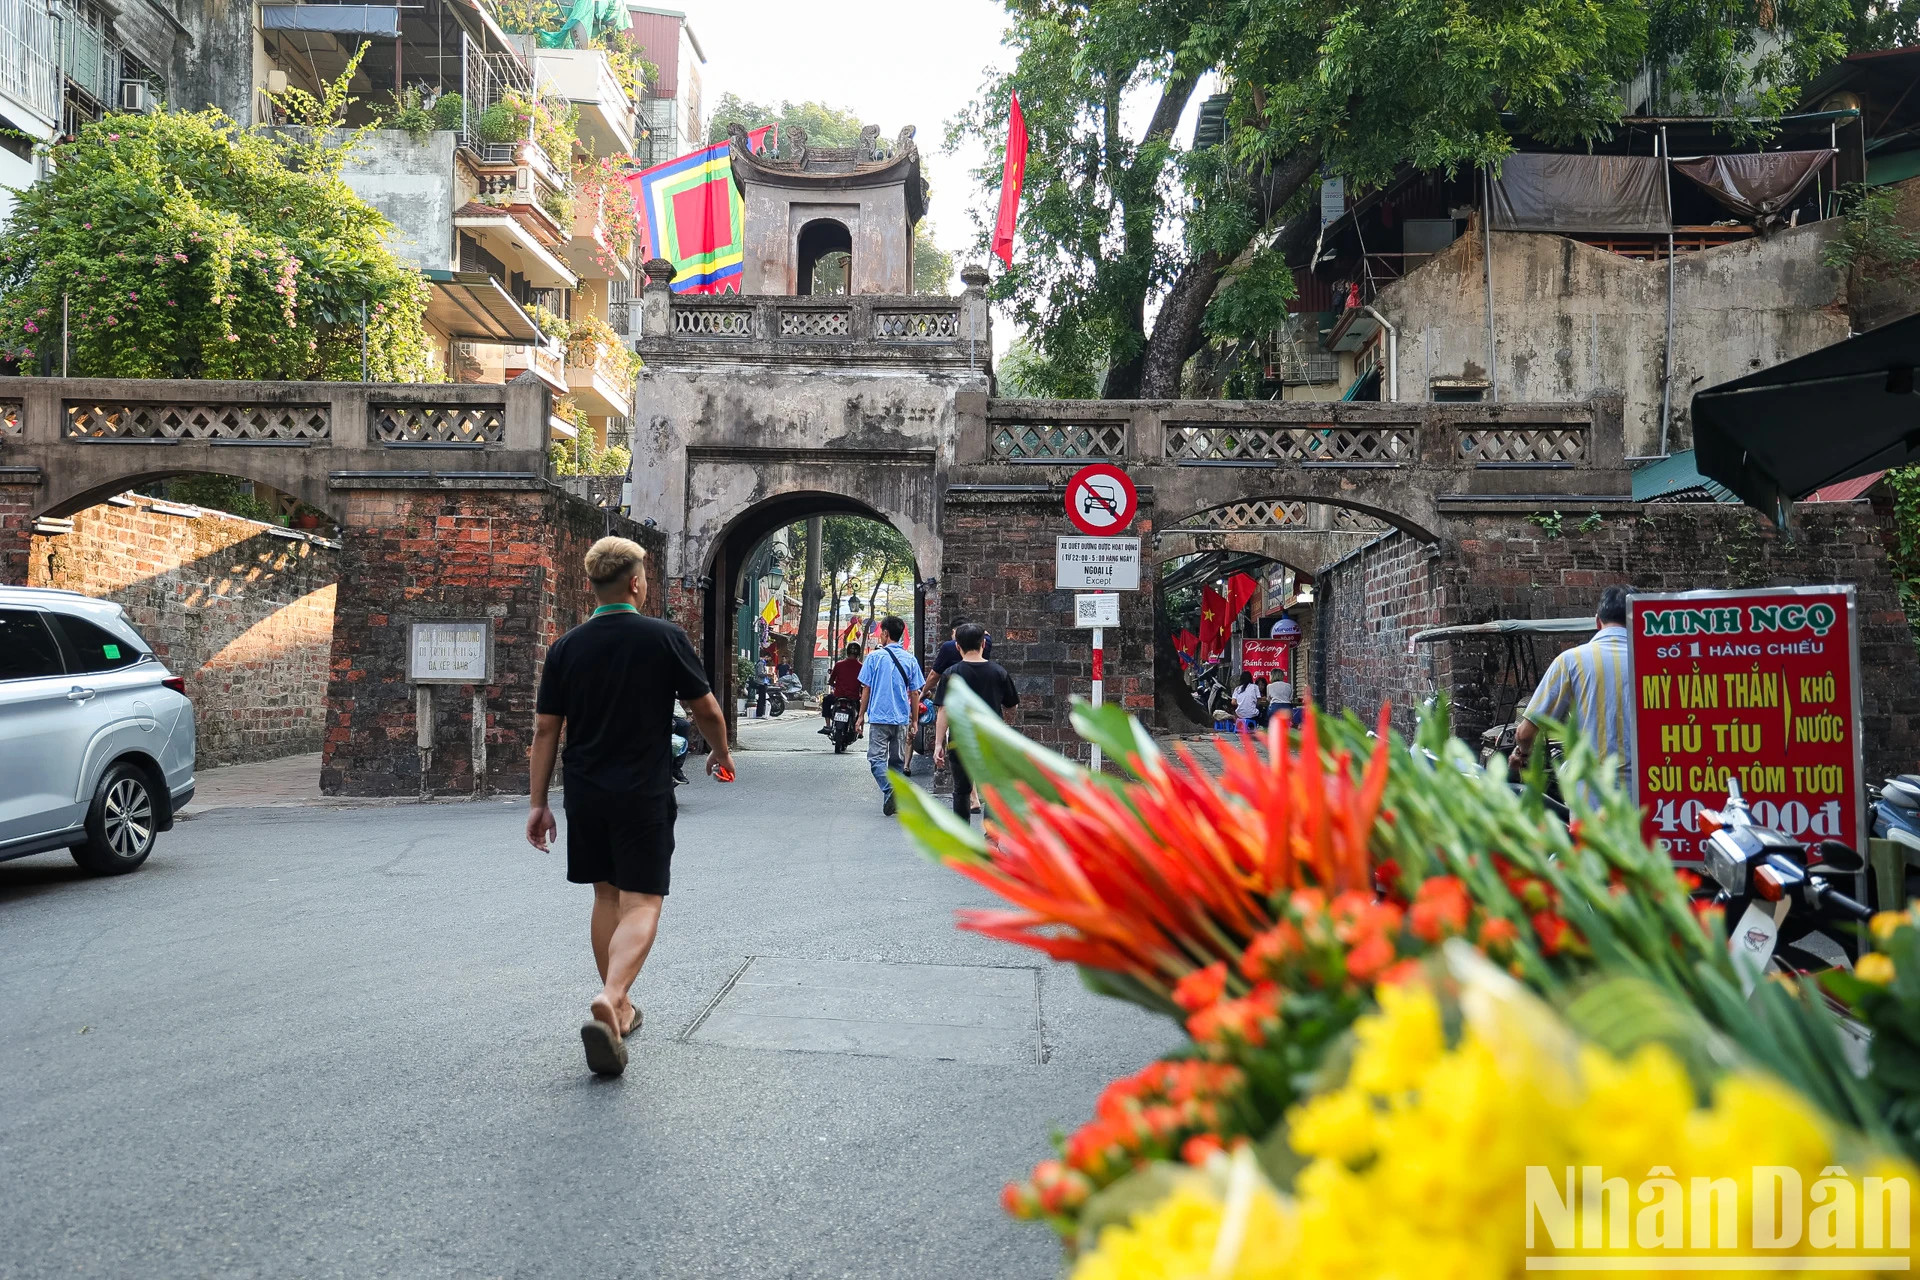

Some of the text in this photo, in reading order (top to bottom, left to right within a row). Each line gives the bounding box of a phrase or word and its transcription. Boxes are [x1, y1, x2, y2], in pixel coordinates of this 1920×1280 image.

[1084, 564, 1113, 576] NGOẠI LỆ
[1086, 576, 1111, 586] Except
[1642, 603, 1836, 636] MINH NGỌ
[1657, 637, 1824, 658] SỐ 1 HÀNG CHIẾU
[1643, 661, 1778, 709] MỲ VẰN THẮN
[1800, 672, 1836, 703] KHÔ
[1661, 714, 1761, 753] HỦ TÍU
[1796, 709, 1844, 743] NƯỚC
[1648, 756, 1843, 794] SỦI CẢO TÔM TƯƠI
